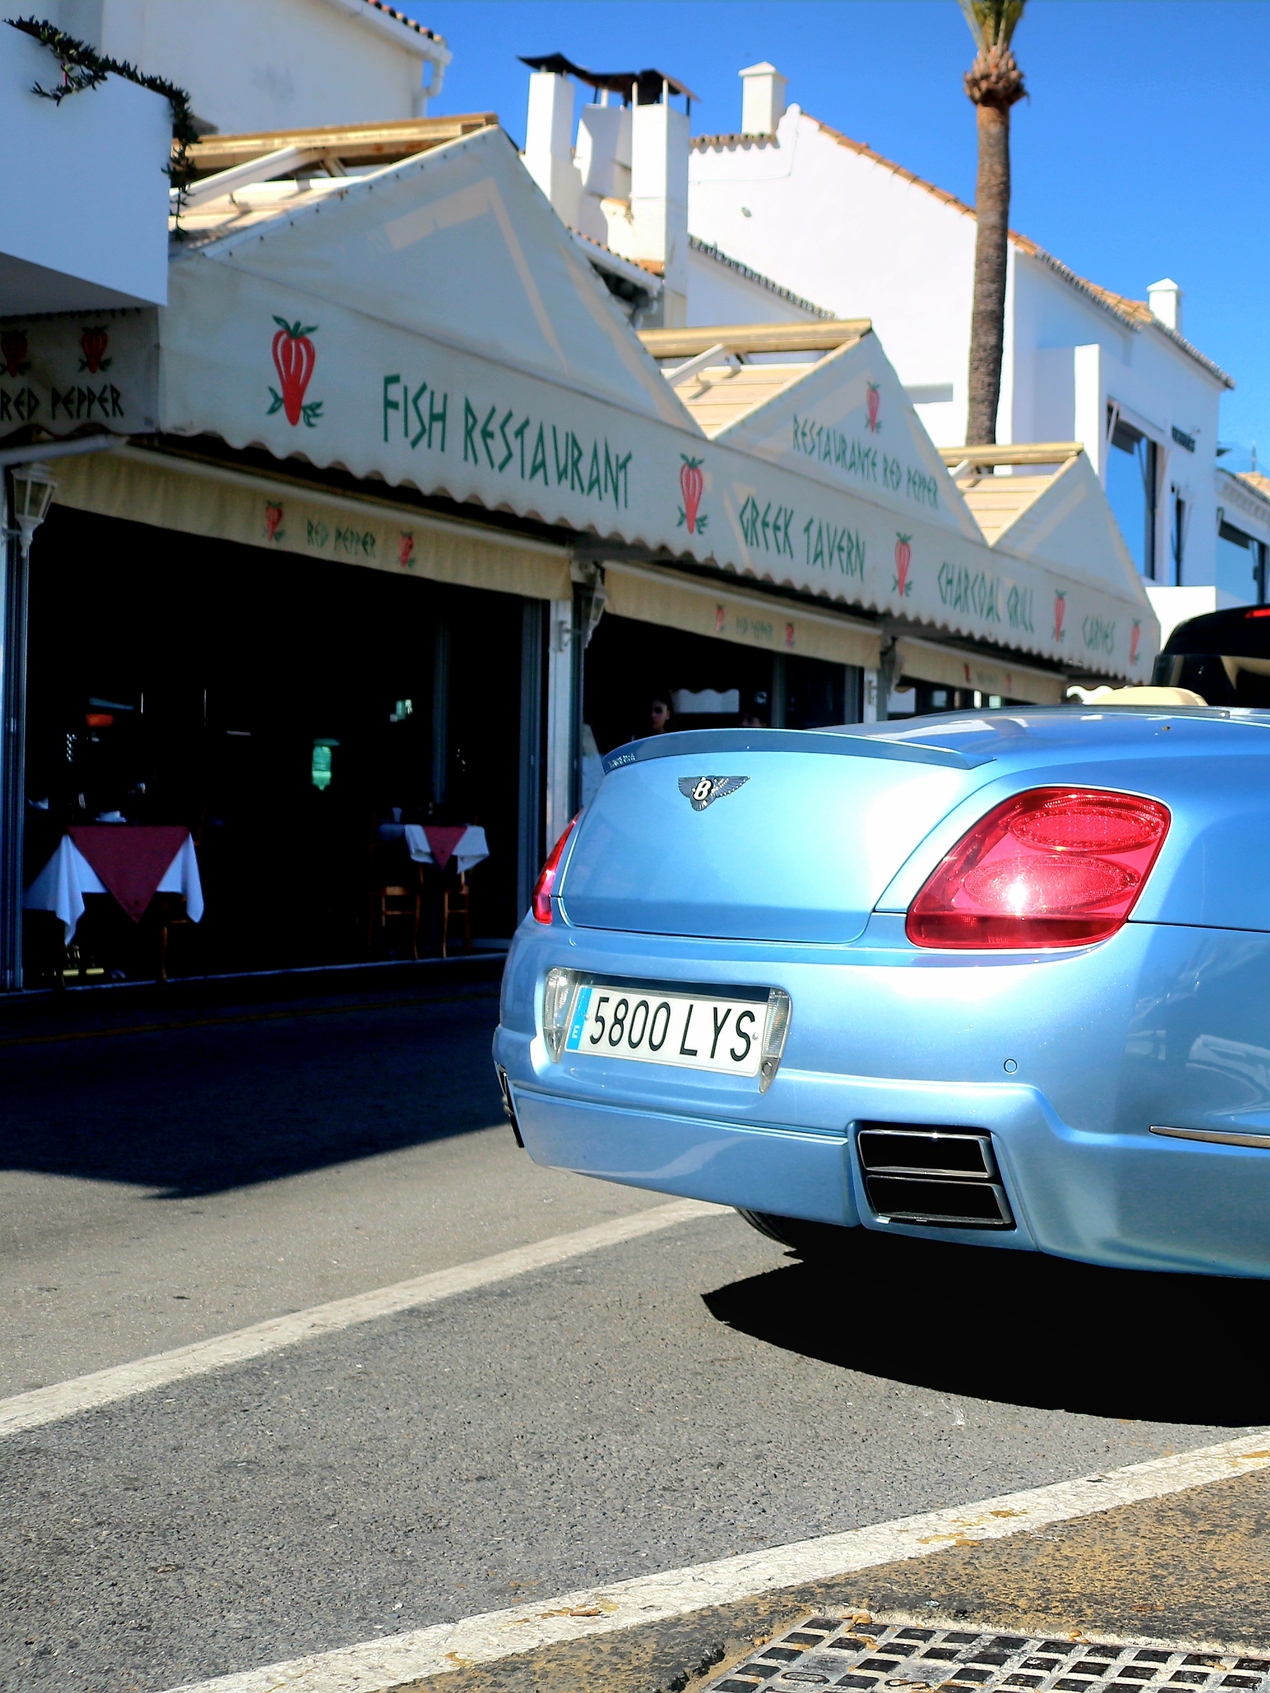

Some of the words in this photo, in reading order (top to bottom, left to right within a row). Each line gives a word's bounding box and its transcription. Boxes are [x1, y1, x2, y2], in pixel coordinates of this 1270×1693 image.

[0, 387, 39, 421] RED
[51, 382, 124, 420] PEPPER
[383, 374, 447, 452] FISH
[463, 395, 632, 511] RESTAURANT
[793, 413, 877, 483] RESTAURANTE
[883, 452, 902, 491] RED
[907, 466, 939, 510] PEPPER
[307, 519, 329, 548] RED
[335, 526, 376, 558] PEPPER
[739, 494, 794, 560] GREEK
[803, 516, 865, 583] TAVERN
[937, 560, 1000, 623] CHARCOAL
[1007, 583, 1034, 634] GRILL
[572, 1025, 580, 1039] E
[590, 996, 671, 1051] 5800
[679, 1004, 756, 1062] LYS
